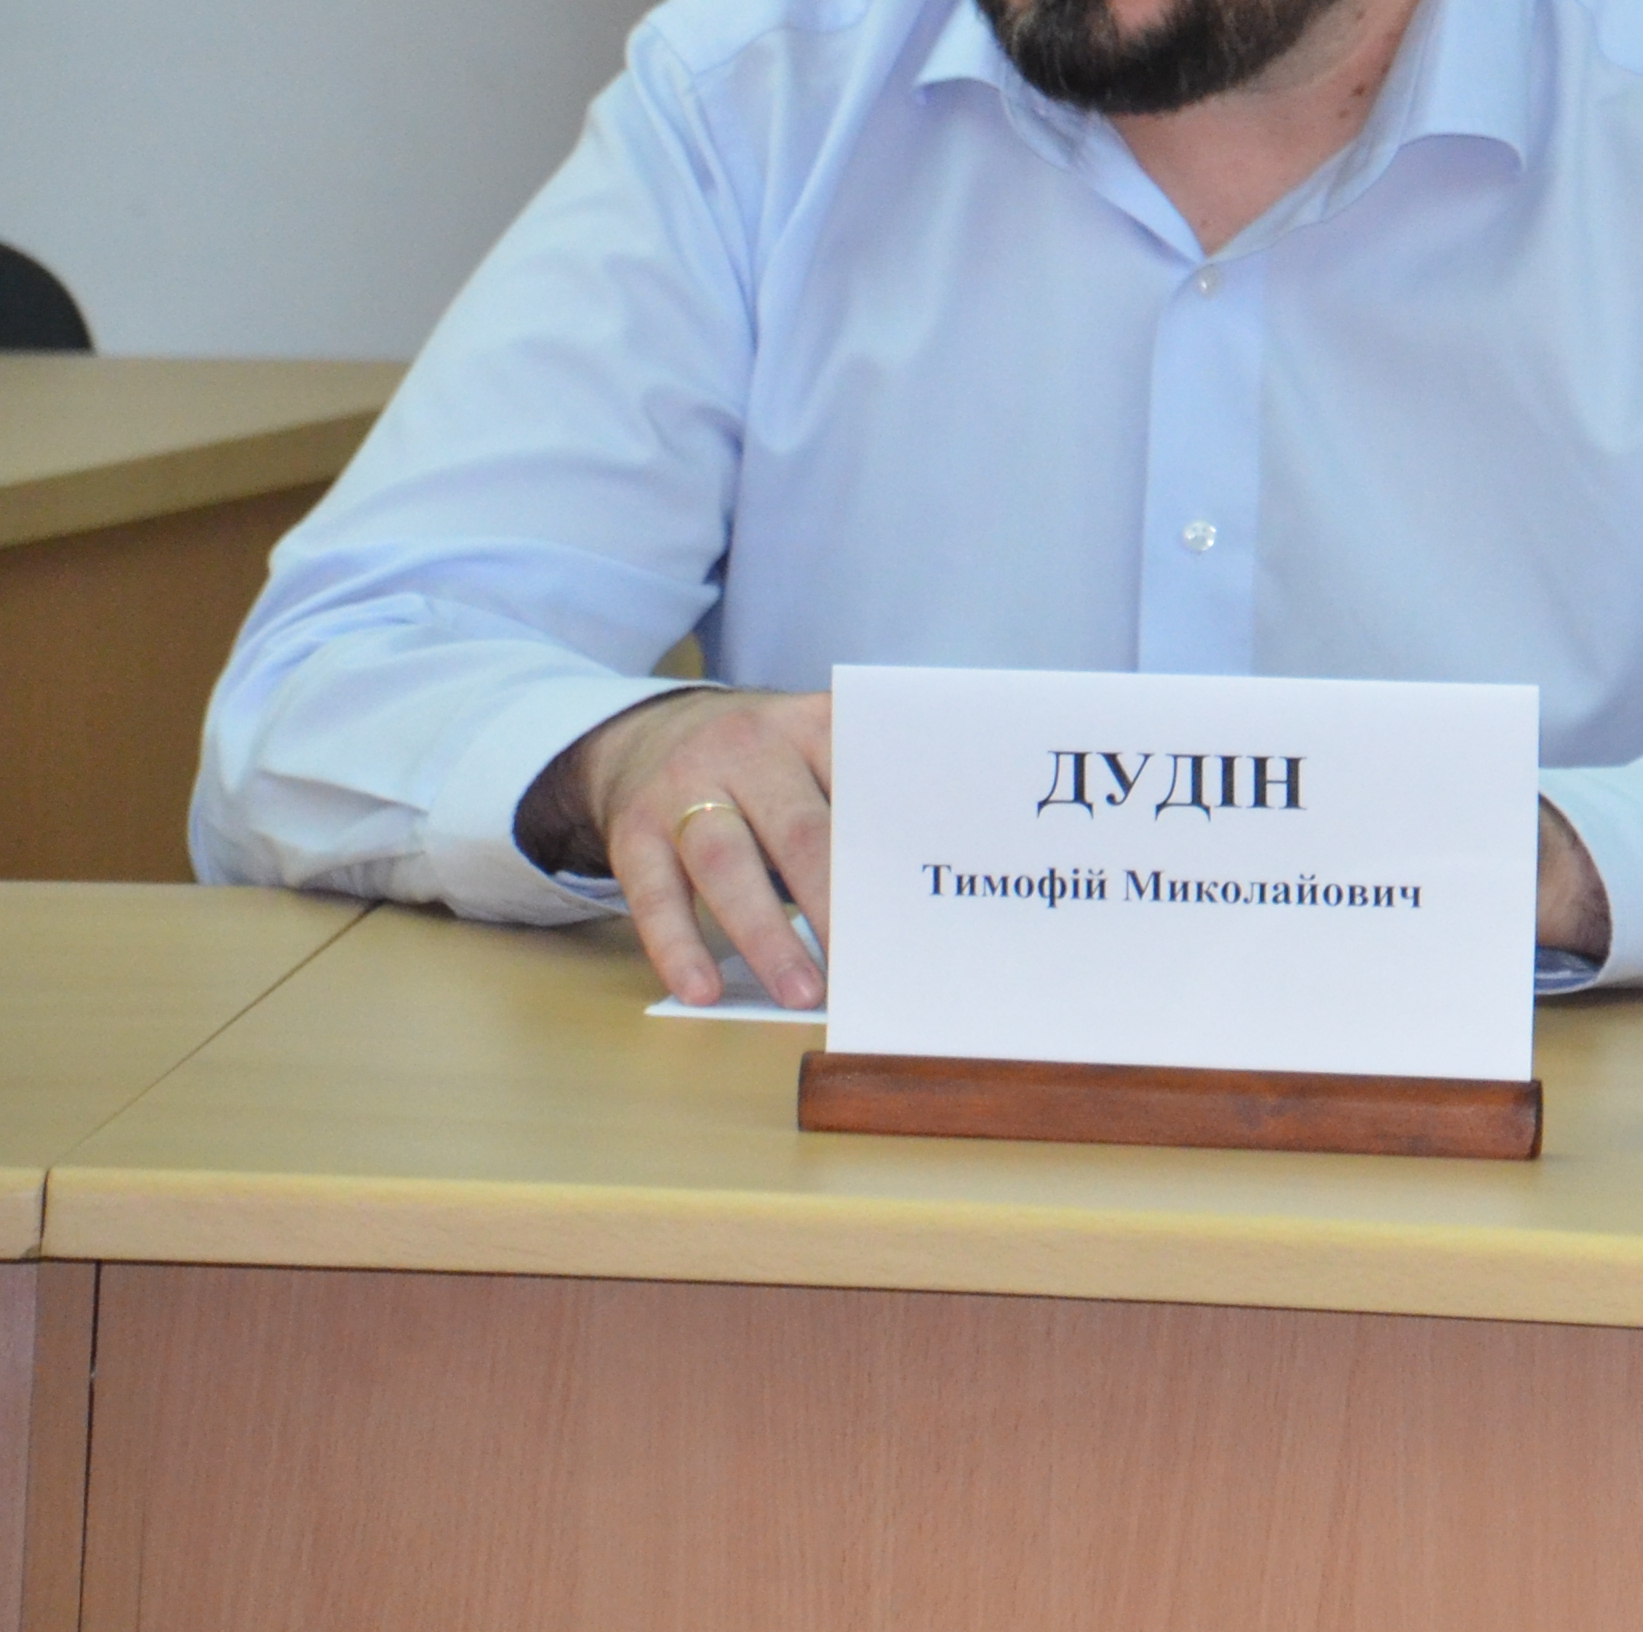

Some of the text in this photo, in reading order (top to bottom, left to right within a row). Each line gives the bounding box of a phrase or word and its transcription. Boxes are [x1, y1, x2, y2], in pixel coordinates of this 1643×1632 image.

[1037, 750, 1308, 820] ДУДІН
[922, 864, 1422, 909] Тимофій Миколайович
